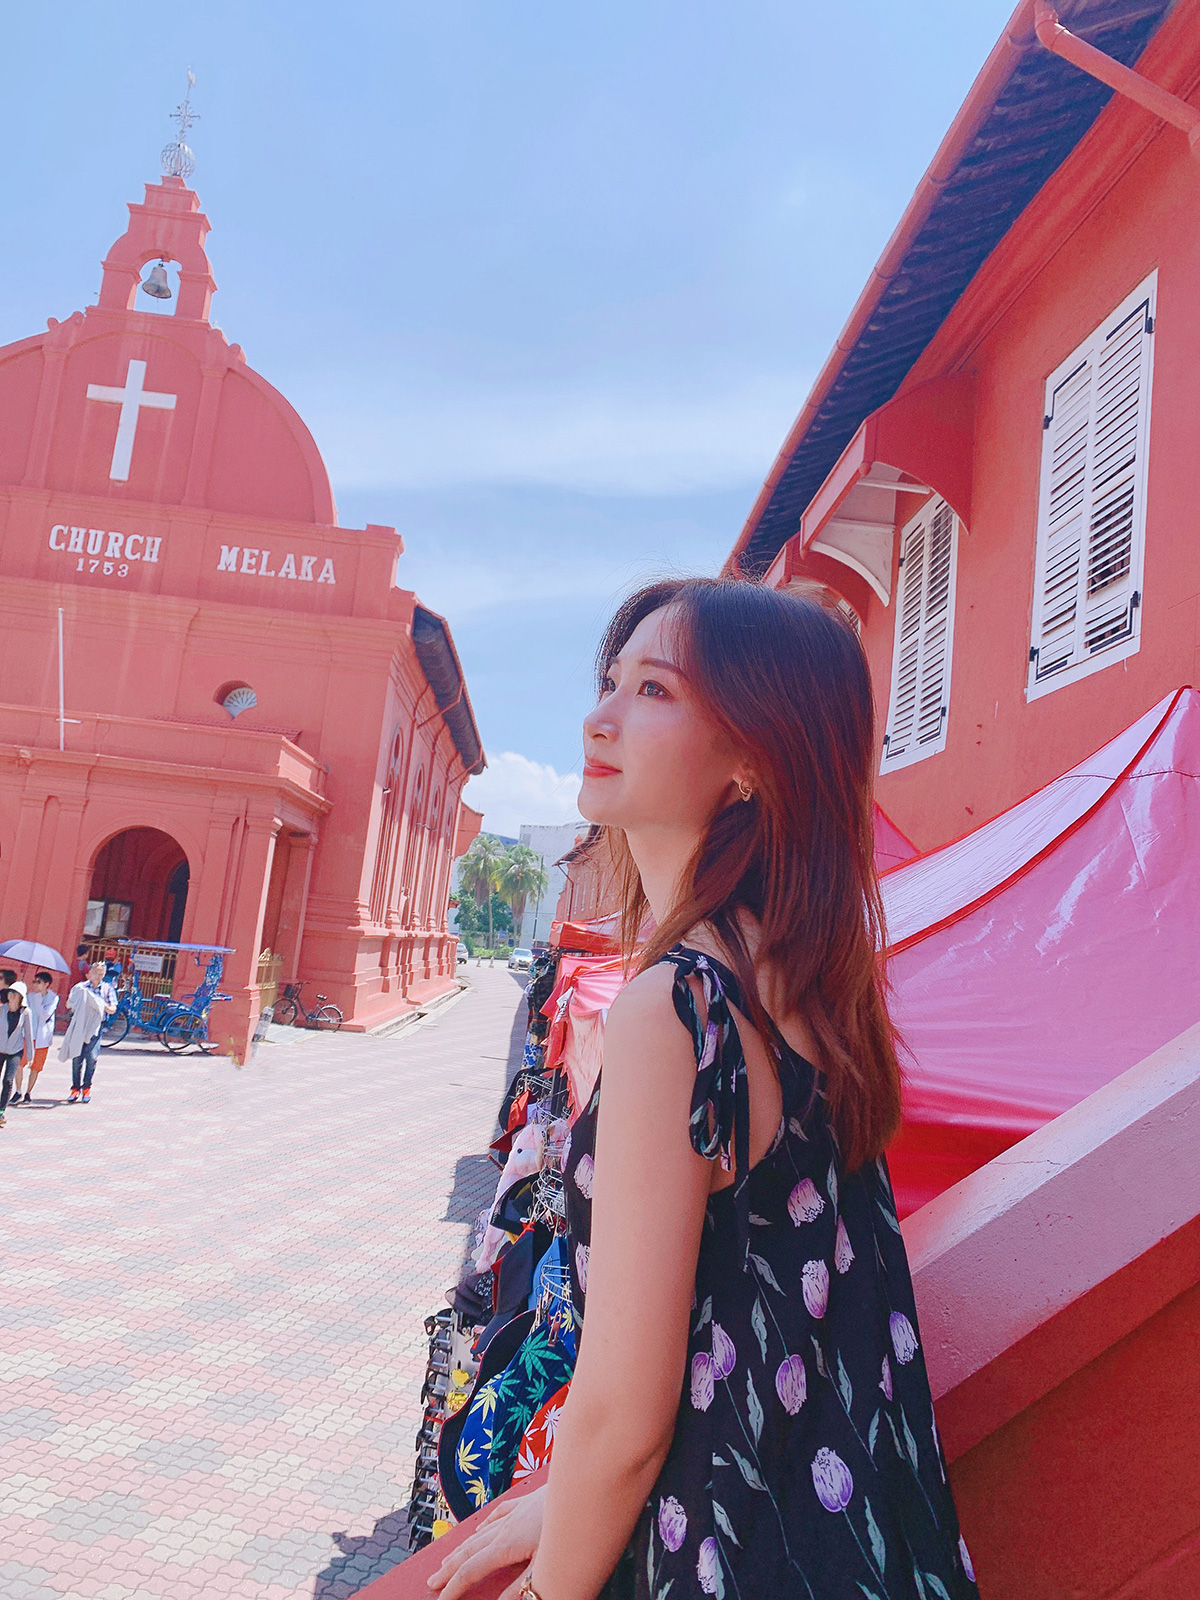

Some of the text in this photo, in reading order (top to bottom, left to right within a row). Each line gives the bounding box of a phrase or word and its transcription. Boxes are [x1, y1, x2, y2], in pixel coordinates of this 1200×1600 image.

[48, 524, 337, 585] CHURCH MELAKA
[76, 557, 129, 578] 1753
